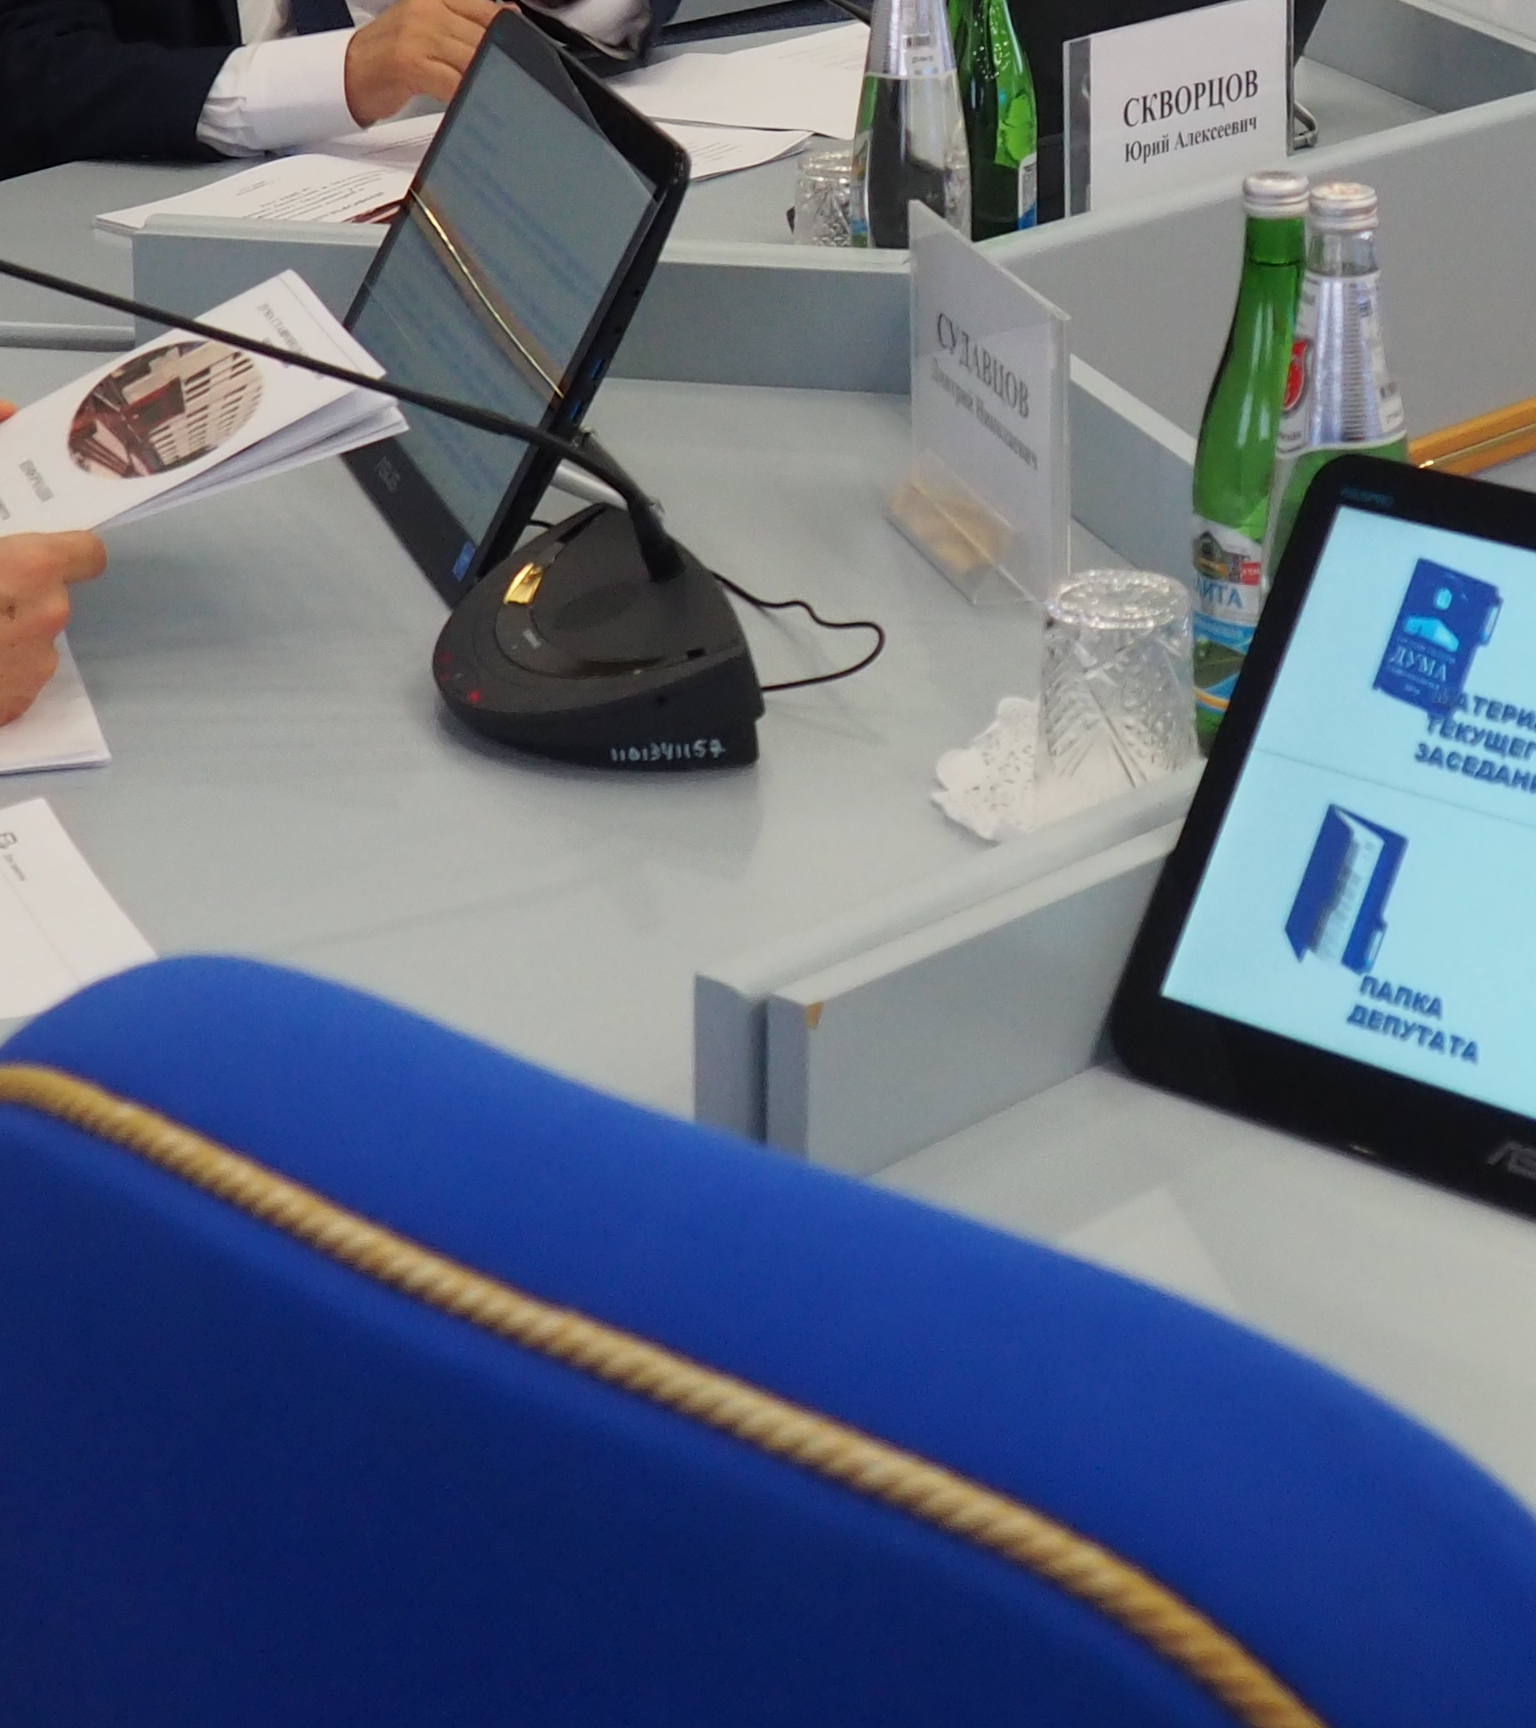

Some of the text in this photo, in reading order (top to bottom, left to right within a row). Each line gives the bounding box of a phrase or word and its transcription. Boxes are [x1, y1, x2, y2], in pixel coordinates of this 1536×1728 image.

[1122, 69, 1259, 128] СКВОРЦОВ
[1124, 116, 1258, 164] Юрий Алексеевич
[936, 312, 1030, 419] СУДАВЦОВ
[1388, 645, 1448, 682] ДУМА
[1359, 974, 1444, 1021] ПАПКА
[1346, 1003, 1479, 1065] ДЕПУТАТА
